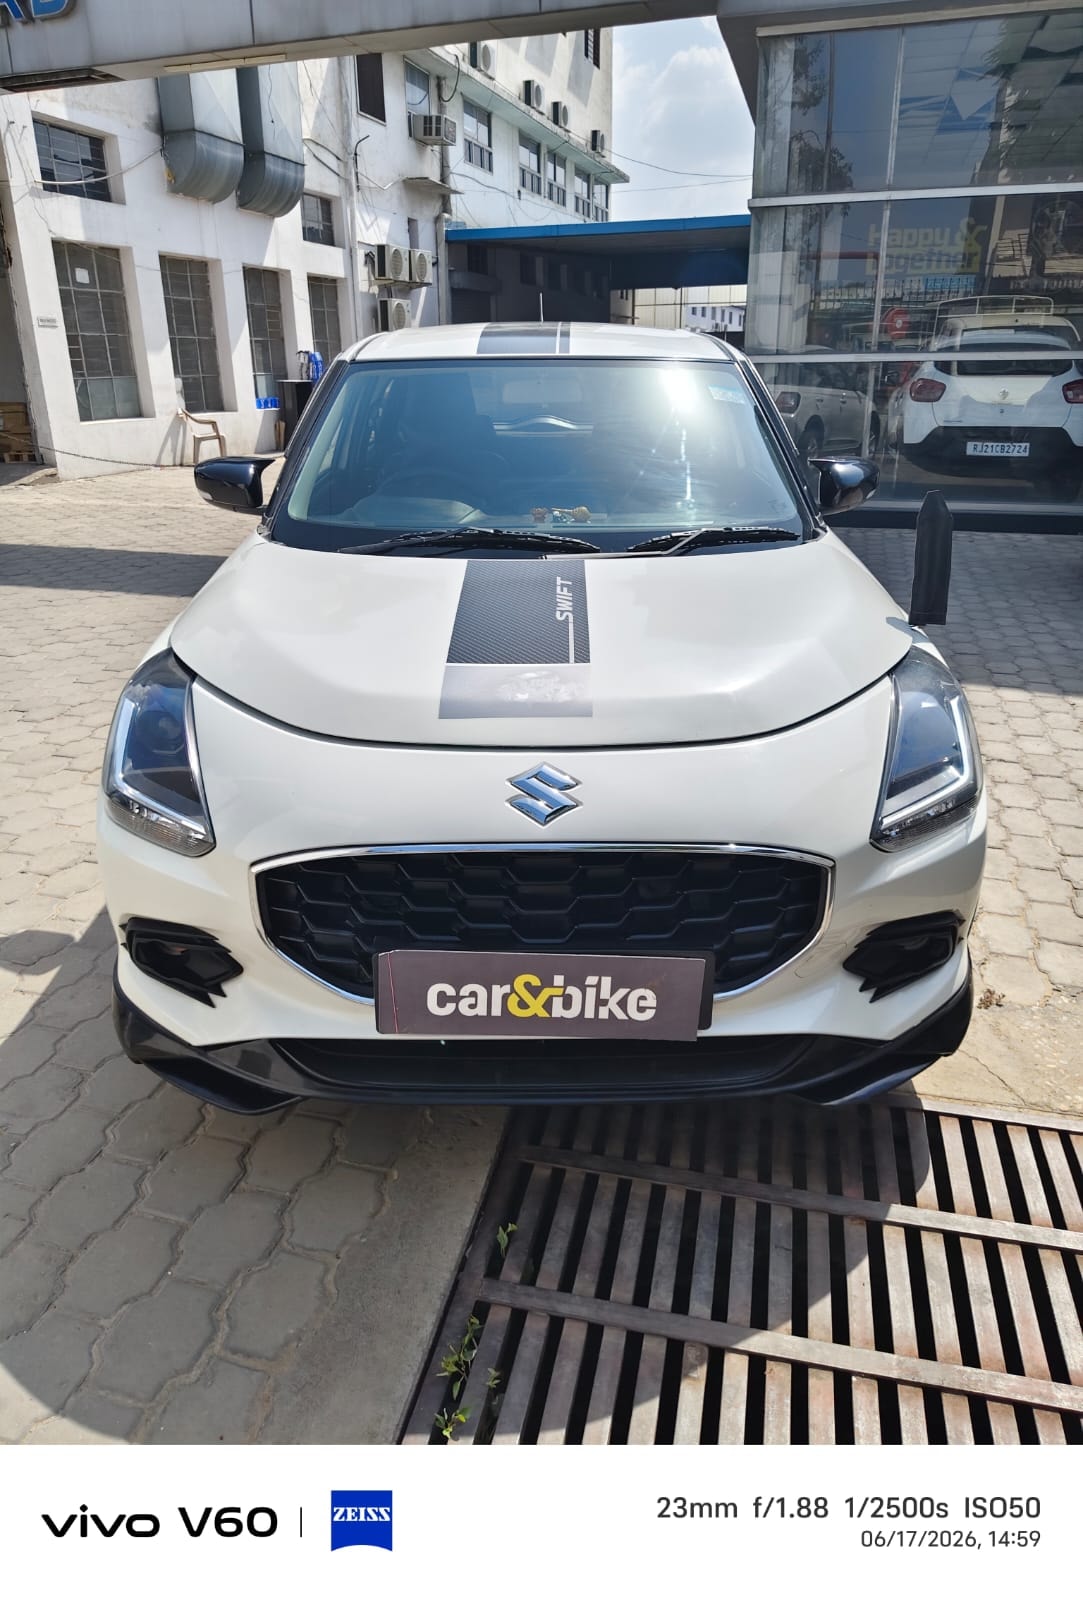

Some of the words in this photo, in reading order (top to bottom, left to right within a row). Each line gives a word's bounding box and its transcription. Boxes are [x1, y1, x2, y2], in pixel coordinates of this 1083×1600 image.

[868, 223, 951, 249] Happy
[973, 443, 1028, 454] RJ21CB2724
[555, 576, 573, 622] SWIFT
[426, 973, 657, 1022] car&bike
